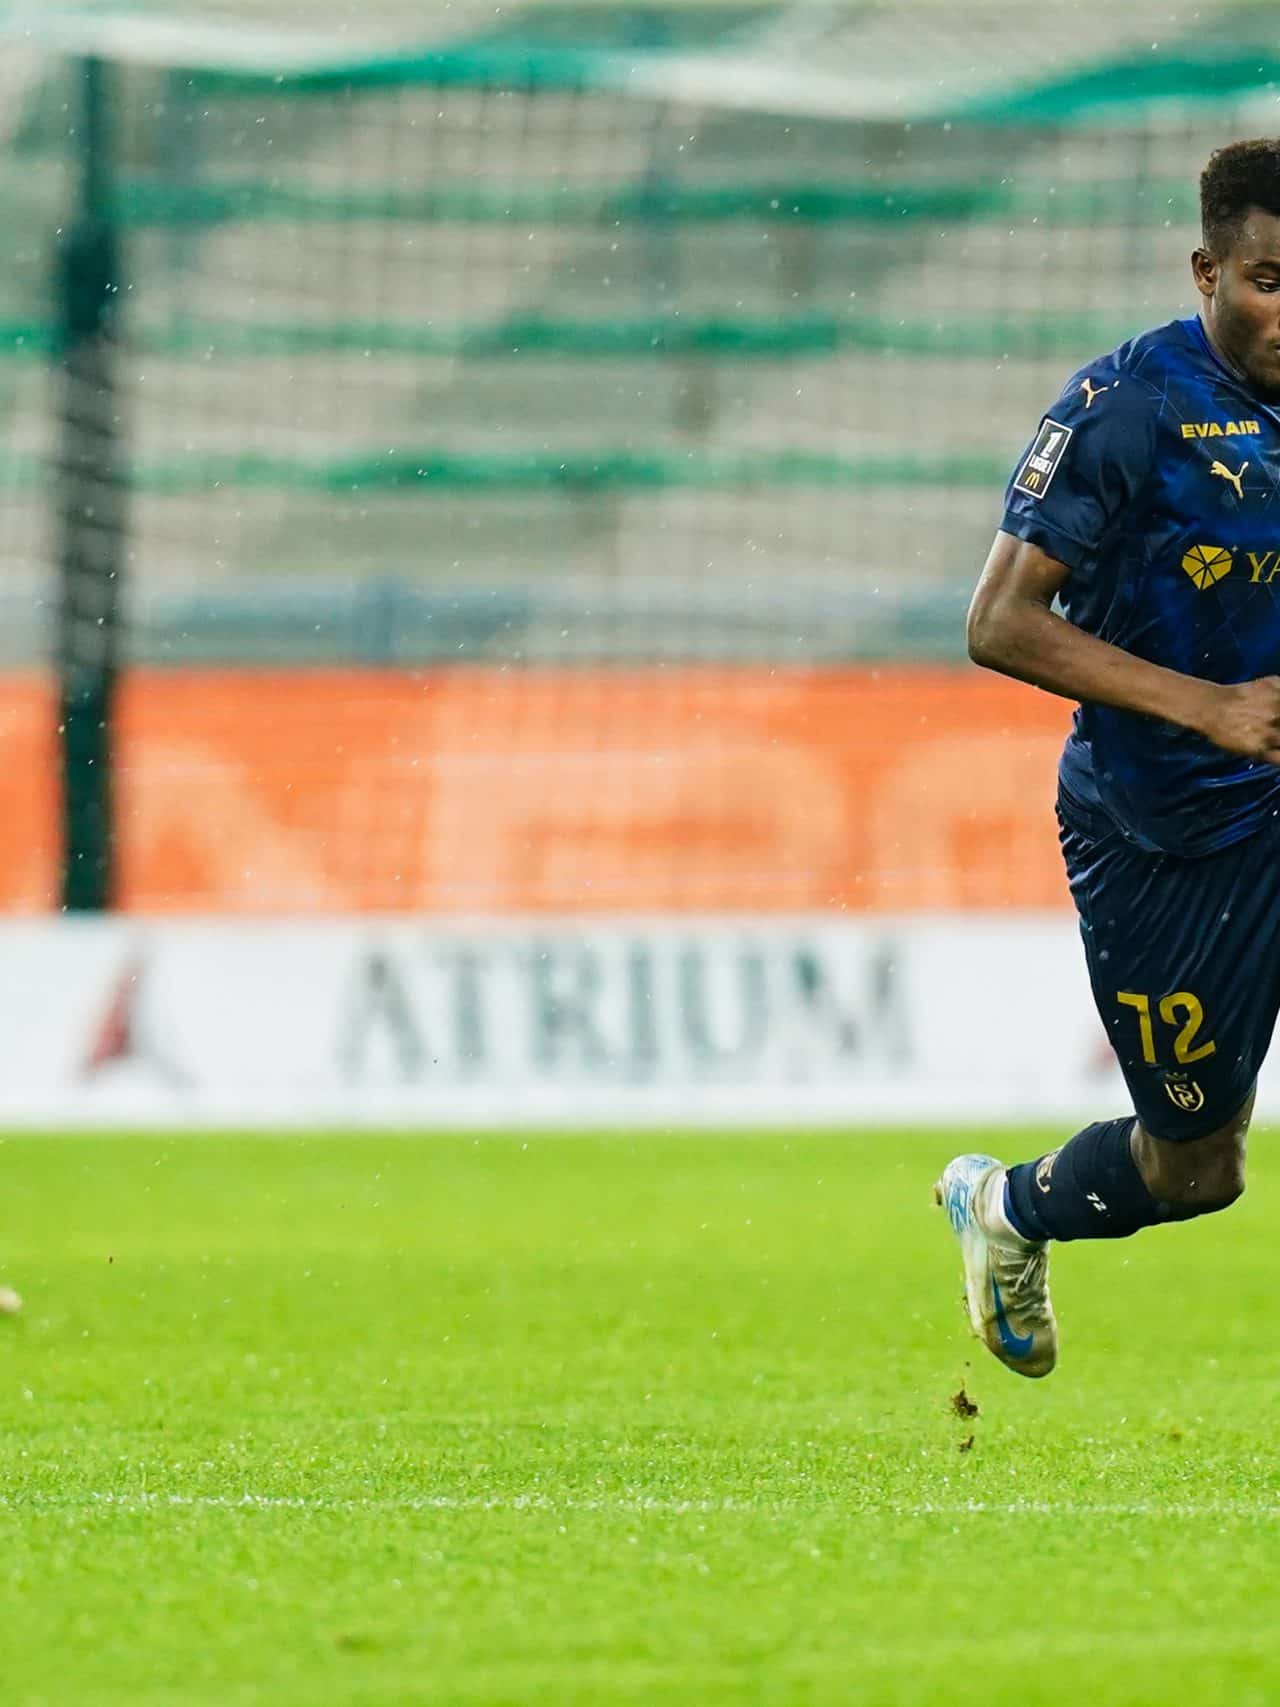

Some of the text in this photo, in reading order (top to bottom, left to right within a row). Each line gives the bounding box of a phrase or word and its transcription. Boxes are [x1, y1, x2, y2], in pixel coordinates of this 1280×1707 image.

[1181, 420, 1261, 438] EVA AIR
[338, 934, 914, 1084] ATRIUM
[1117, 992, 1216, 1064] 72
